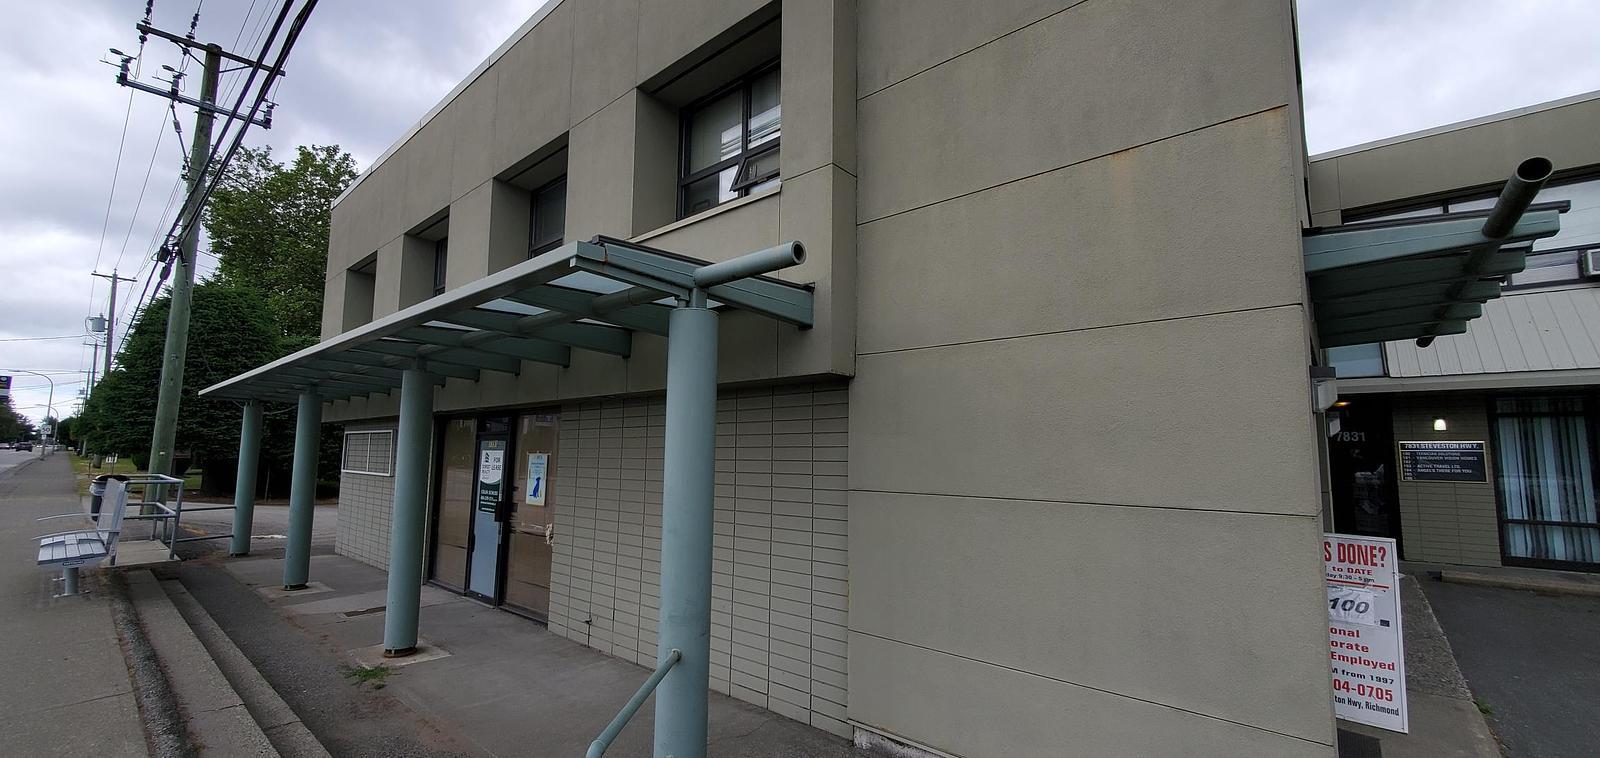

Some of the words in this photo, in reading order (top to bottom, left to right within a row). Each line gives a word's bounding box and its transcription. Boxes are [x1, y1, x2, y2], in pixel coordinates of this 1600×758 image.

[1337, 431, 1366, 442] 7831
[1337, 542, 1387, 568] DONE?
[1347, 567, 1373, 576] DATE
[1329, 597, 1370, 614] 100
[1330, 626, 1360, 638] onal
[1330, 639, 1369, 653] orate
[1330, 651, 1396, 672] Employed
[1341, 669, 1366, 679] from
[1370, 674, 1394, 685] 1997
[1333, 678, 1393, 702] 04-0705
[1334, 695, 1346, 704] ton
[1365, 701, 1400, 716] Richmond
